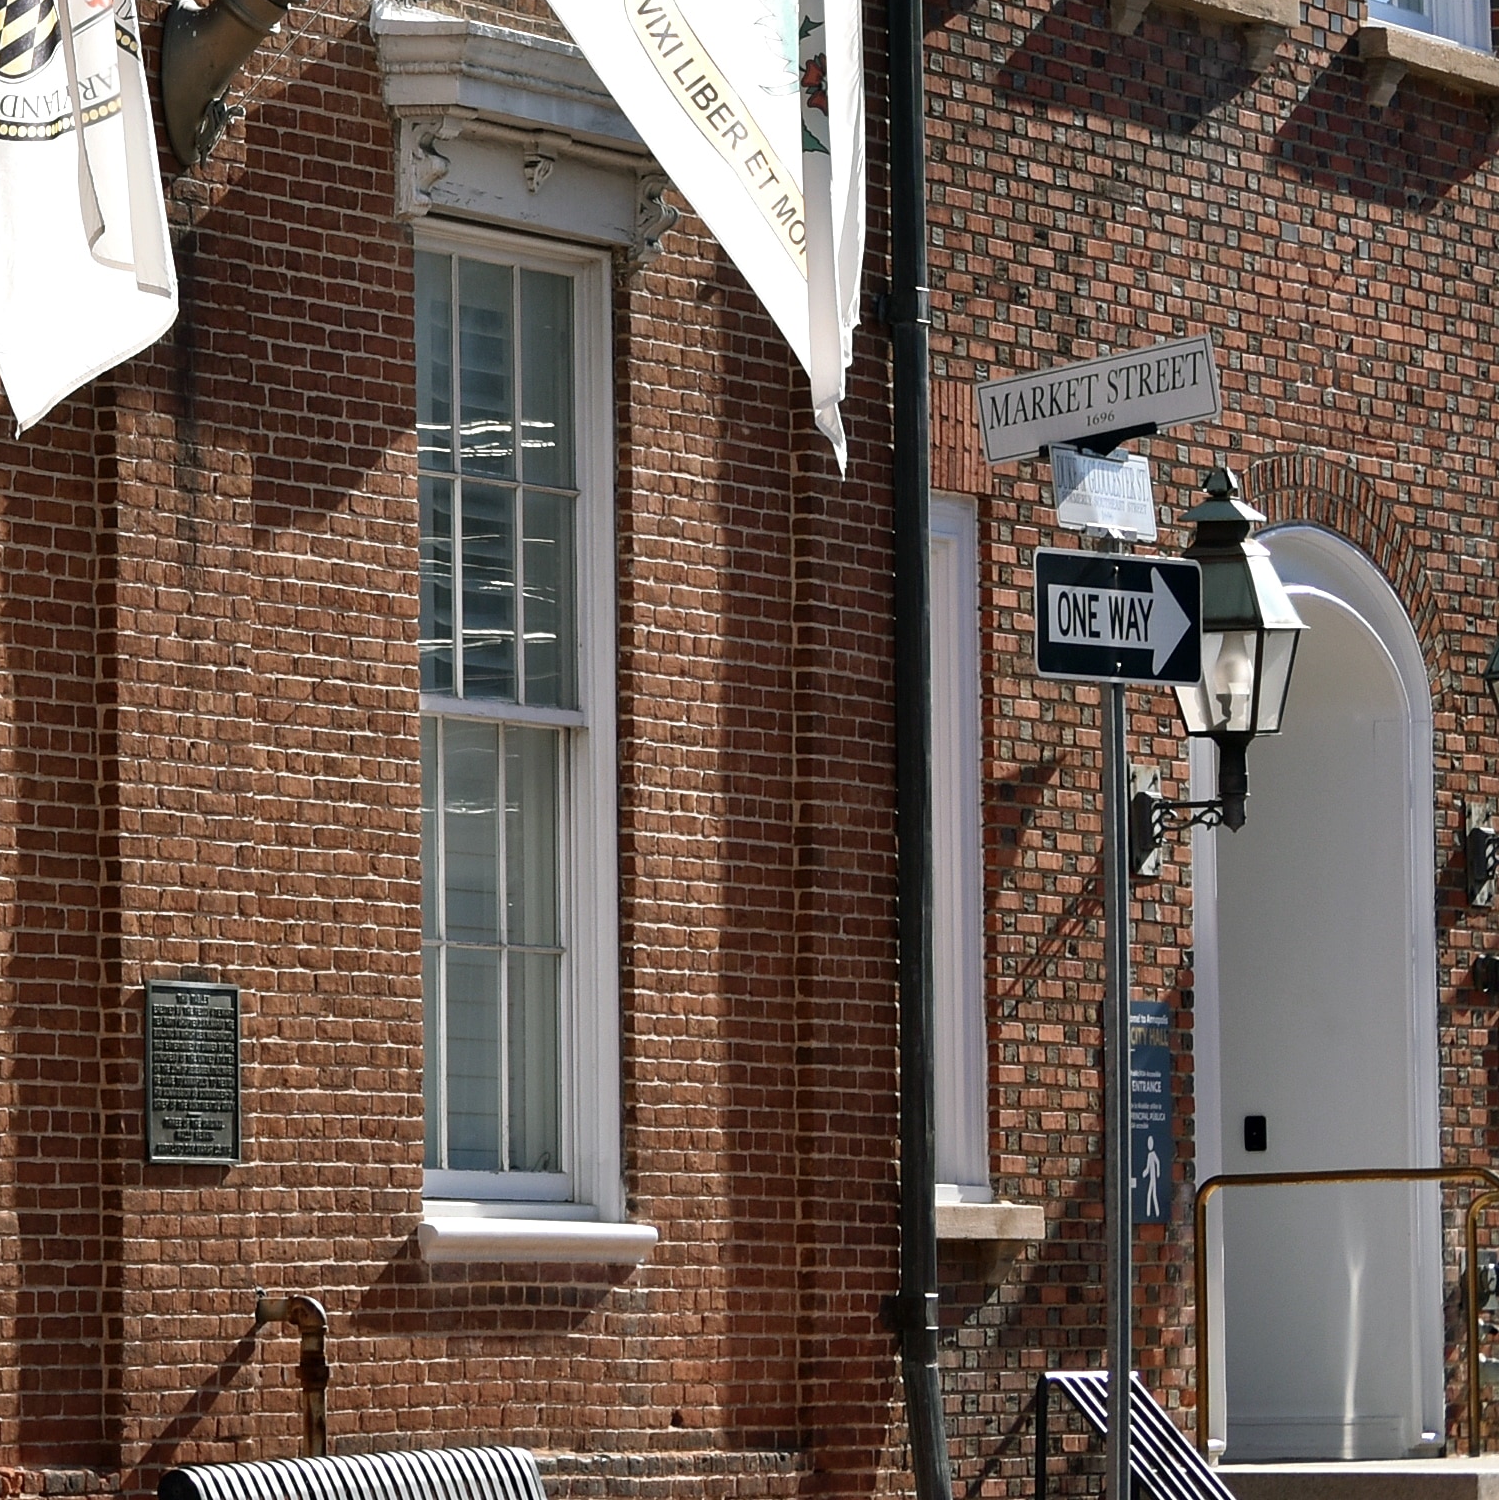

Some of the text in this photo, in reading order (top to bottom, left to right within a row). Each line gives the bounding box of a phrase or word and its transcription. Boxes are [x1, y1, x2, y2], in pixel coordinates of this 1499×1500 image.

[673, 57, 748, 151] LIBER
[743, 149, 780, 190] ET
[989, 349, 1205, 431] MARKET STREET
[1086, 409, 1116, 427] 1696
[1057, 590, 1153, 642] ONE WAY
[1131, 1027, 1169, 1047] CITY HALL
[1131, 1080, 1162, 1093] ENTRANCE
